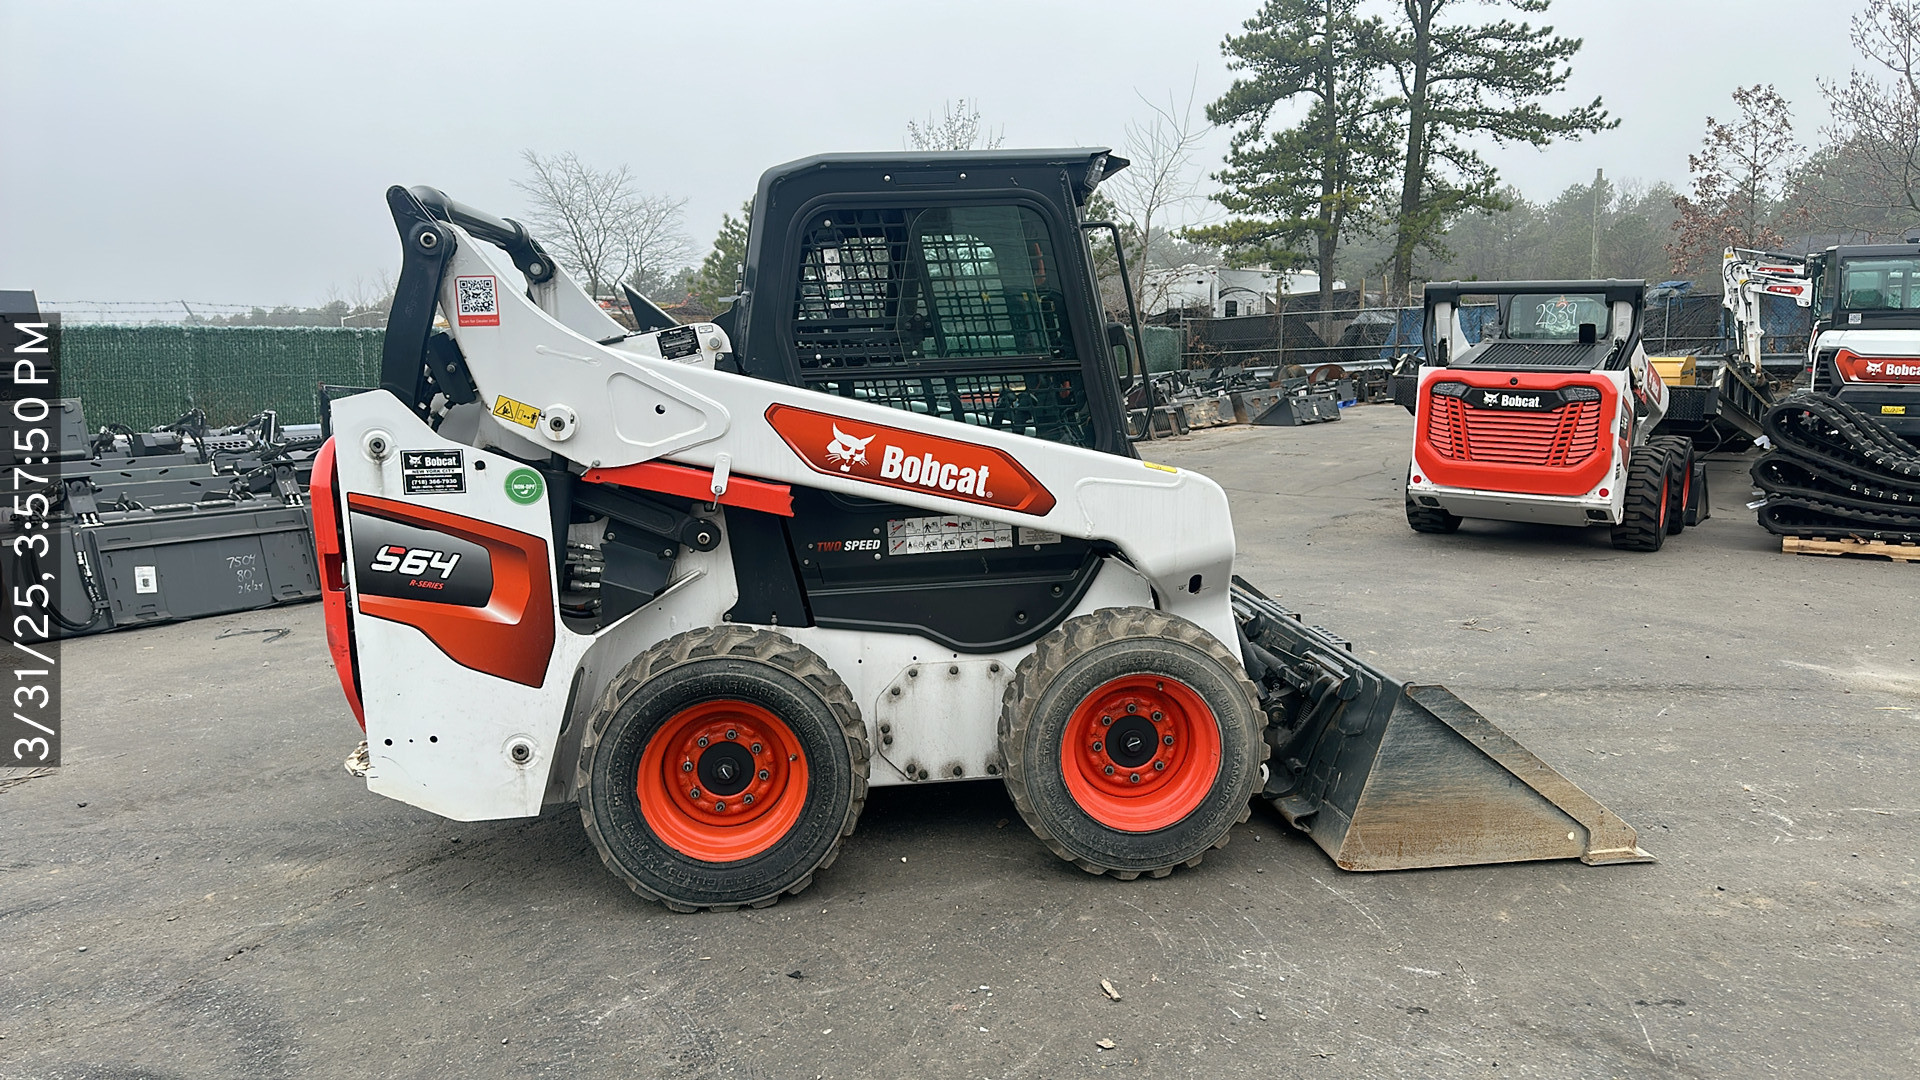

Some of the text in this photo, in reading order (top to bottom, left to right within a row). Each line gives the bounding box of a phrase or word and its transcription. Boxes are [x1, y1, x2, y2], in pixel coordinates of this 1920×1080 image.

[1535, 302, 1578, 325] 2839
[1501, 394, 1541, 408] Bobcat
[424, 456, 457, 467] Bobcat
[880, 444, 991, 498] Bobcat
[817, 539, 881, 552] TWO SPEED
[226, 554, 256, 569] 7504
[370, 545, 461, 579] S64
[409, 579, 445, 590] R-SERIES
[1043, 667, 1097, 764] STANDARD DUTY
[1218, 695, 1241, 731] Bobcat
[1216, 746, 1243, 810] STANDARD
